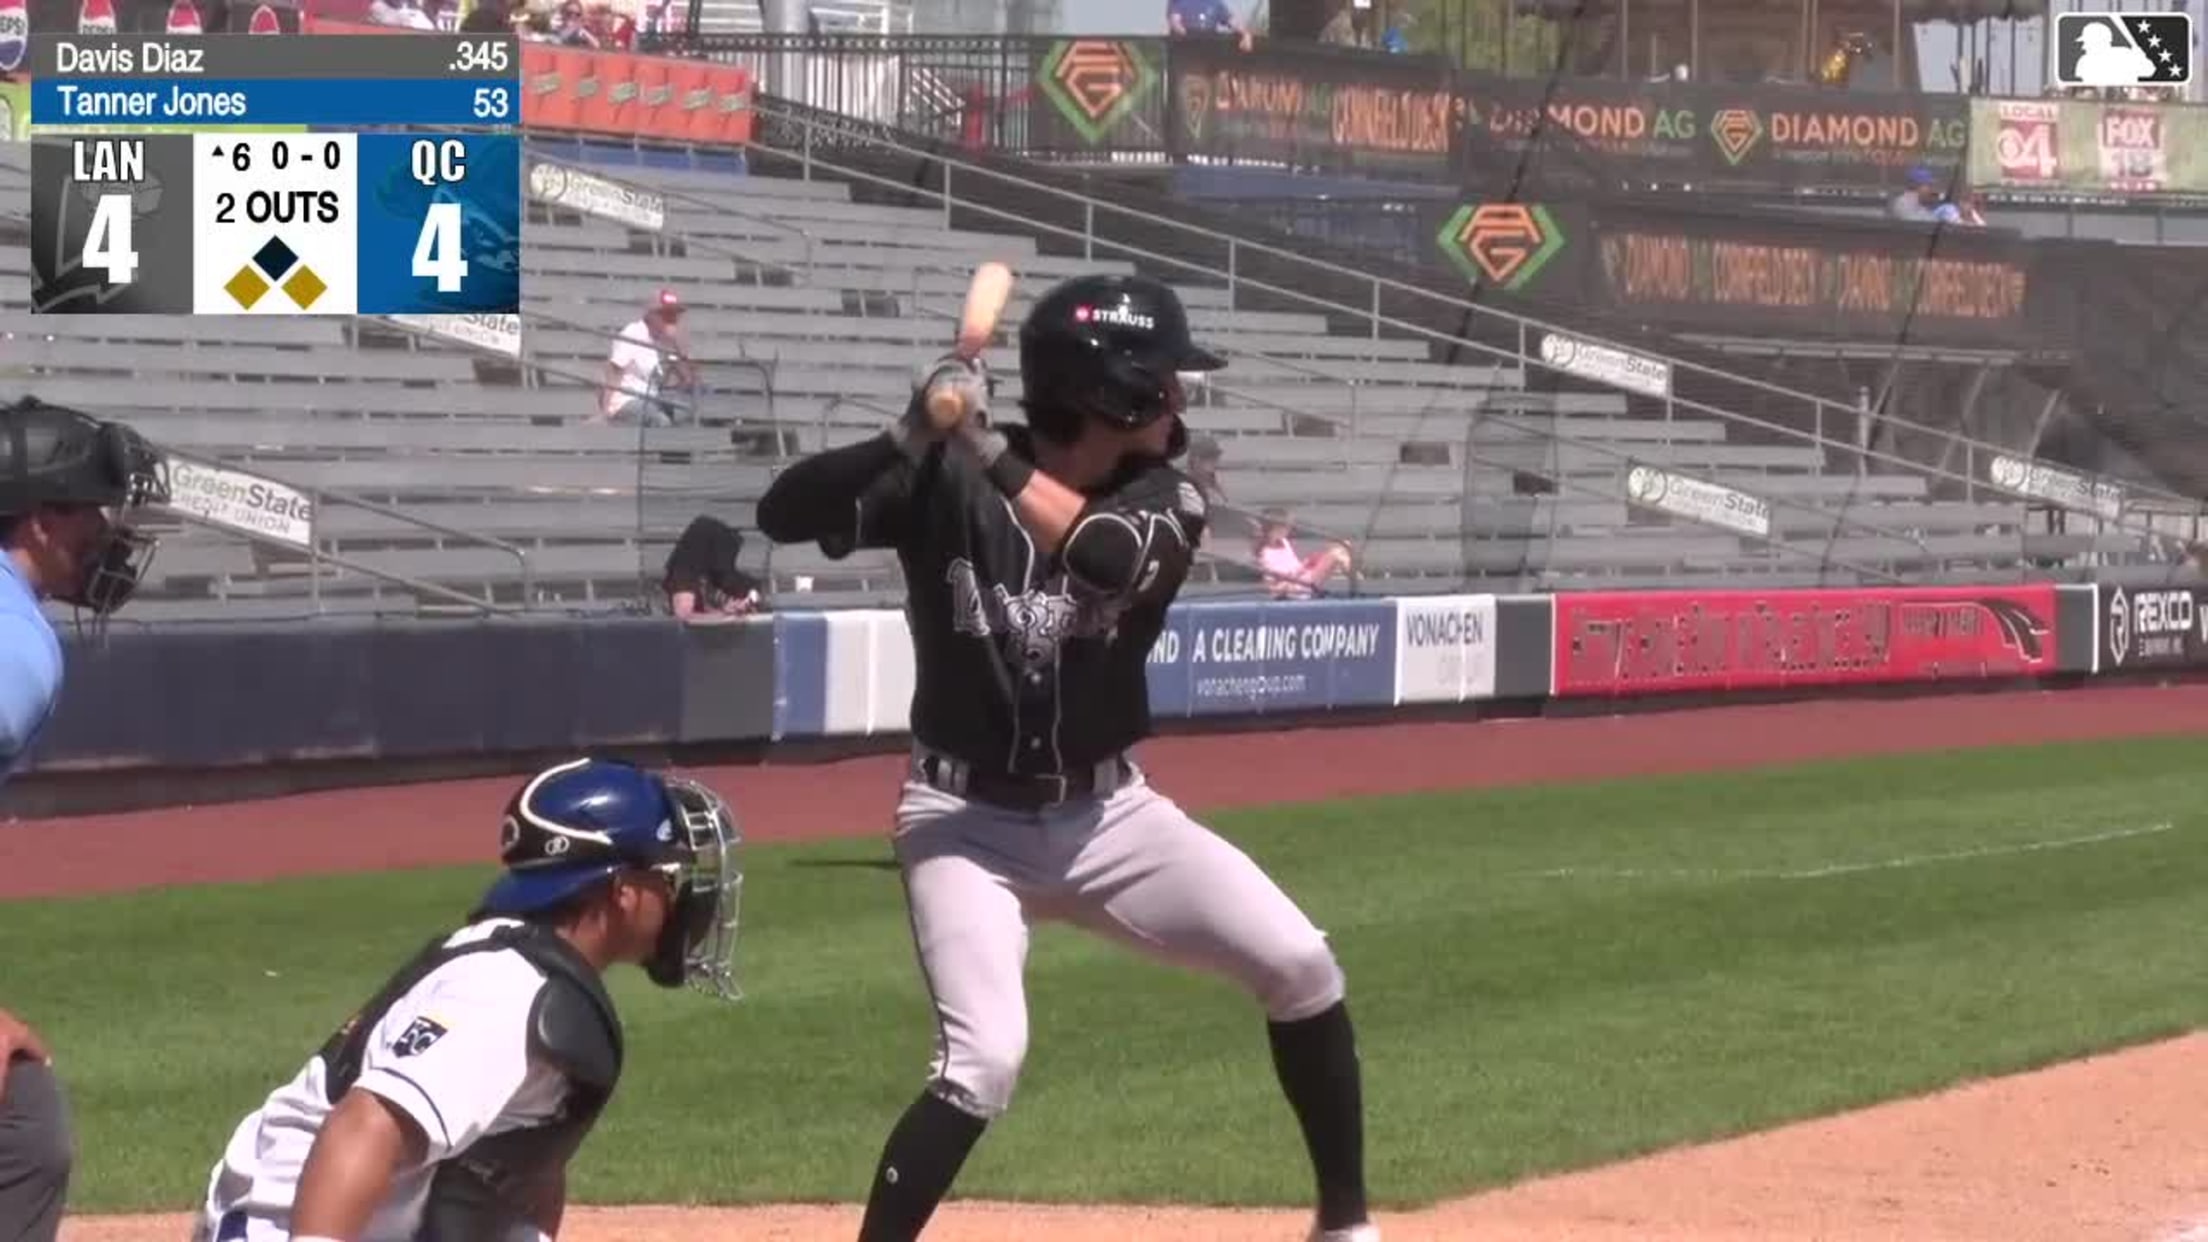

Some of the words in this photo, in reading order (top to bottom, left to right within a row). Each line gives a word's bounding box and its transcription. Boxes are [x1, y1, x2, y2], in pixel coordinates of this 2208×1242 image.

[1652, 109, 1697, 139] AG
[1770, 112, 1920, 148] DIAMOND
[1925, 118, 1966, 149] AG
[2105, 116, 2155, 147] FOX
[173, 464, 314, 522] GreenState
[233, 505, 290, 534] UNION
[2133, 589, 2193, 634] REXCO
[1191, 627, 1206, 664] A
